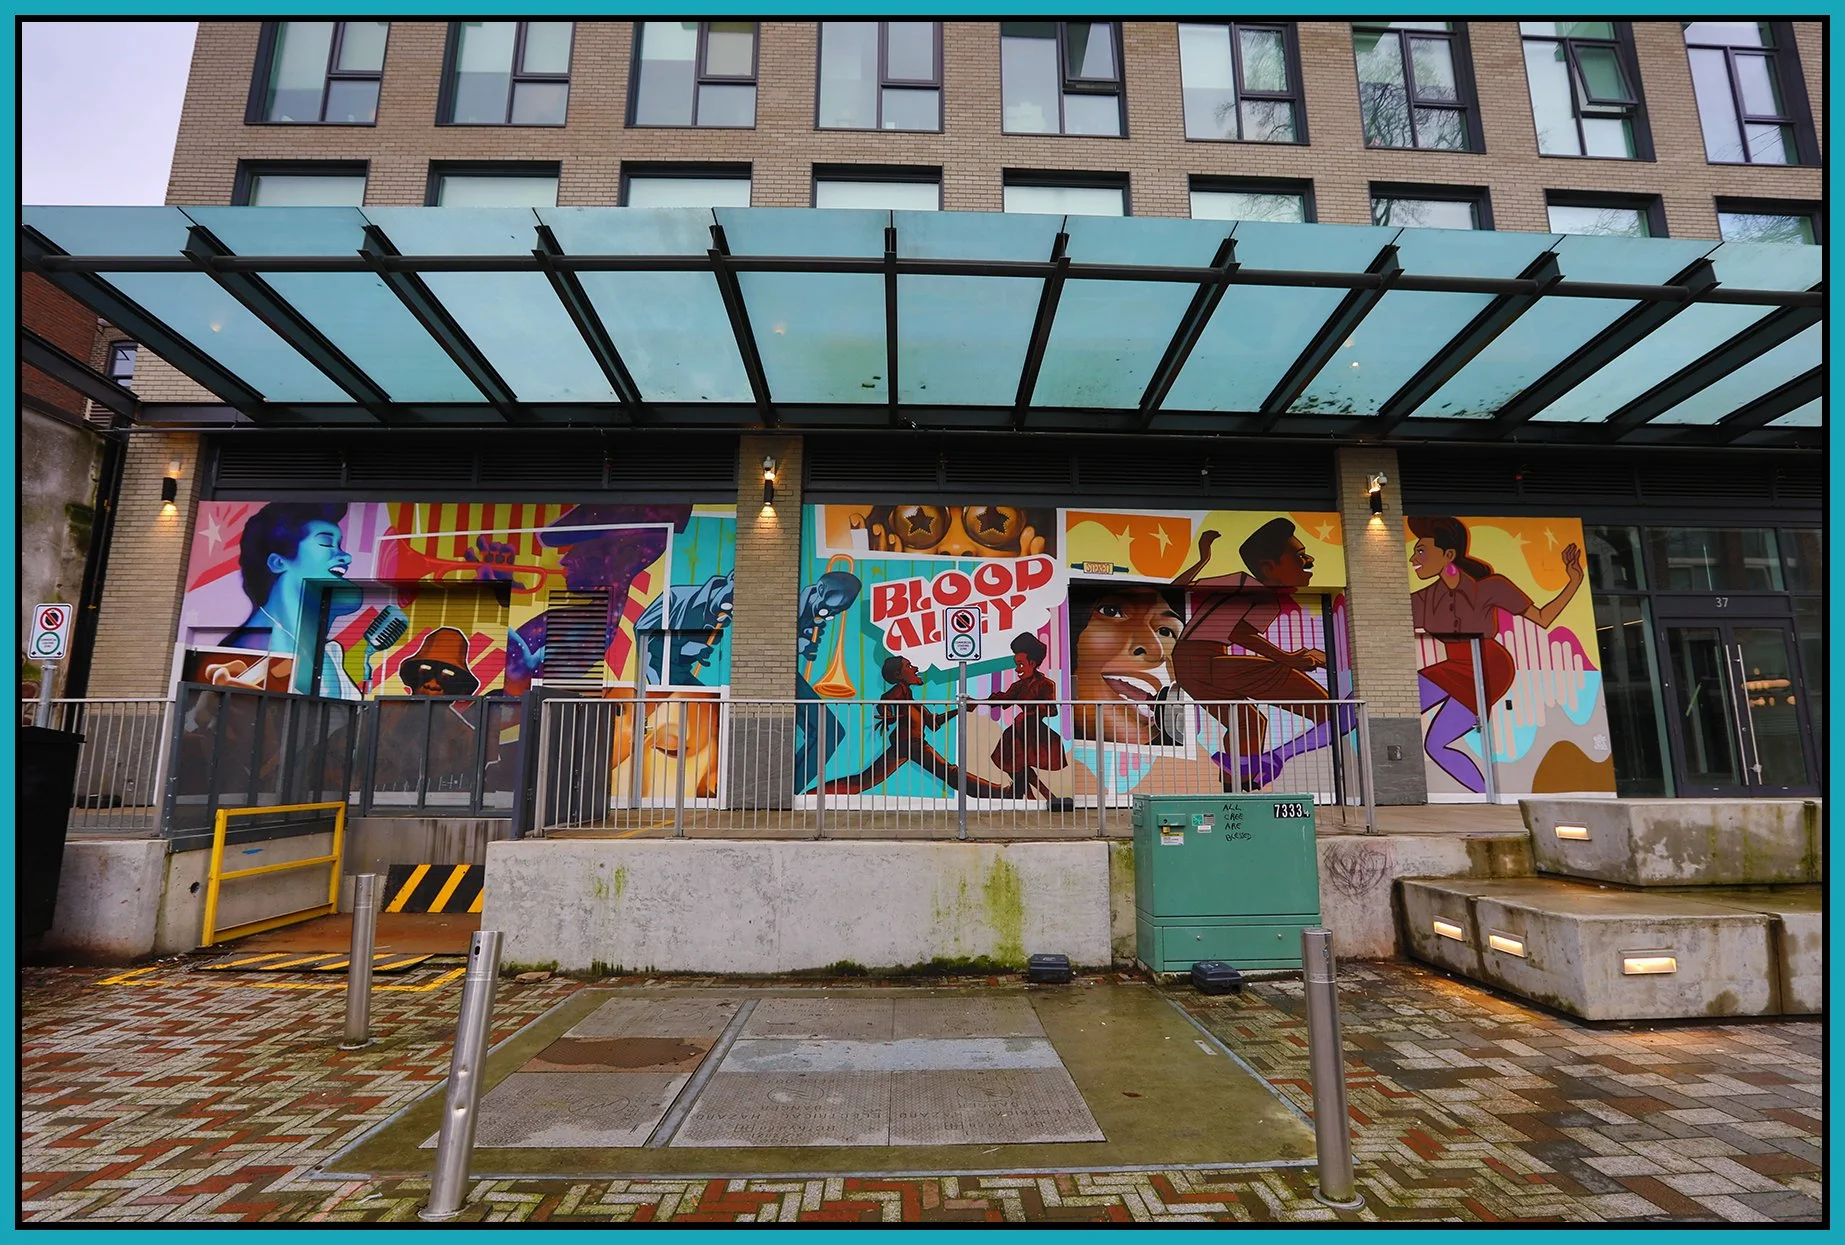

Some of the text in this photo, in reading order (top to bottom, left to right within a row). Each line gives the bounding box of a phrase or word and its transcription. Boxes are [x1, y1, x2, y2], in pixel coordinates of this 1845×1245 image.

[873, 558, 1053, 623] BLOOD
[1715, 597, 1728, 608] 37
[886, 595, 1026, 651] ALY
[1224, 823, 1242, 831] ARE
